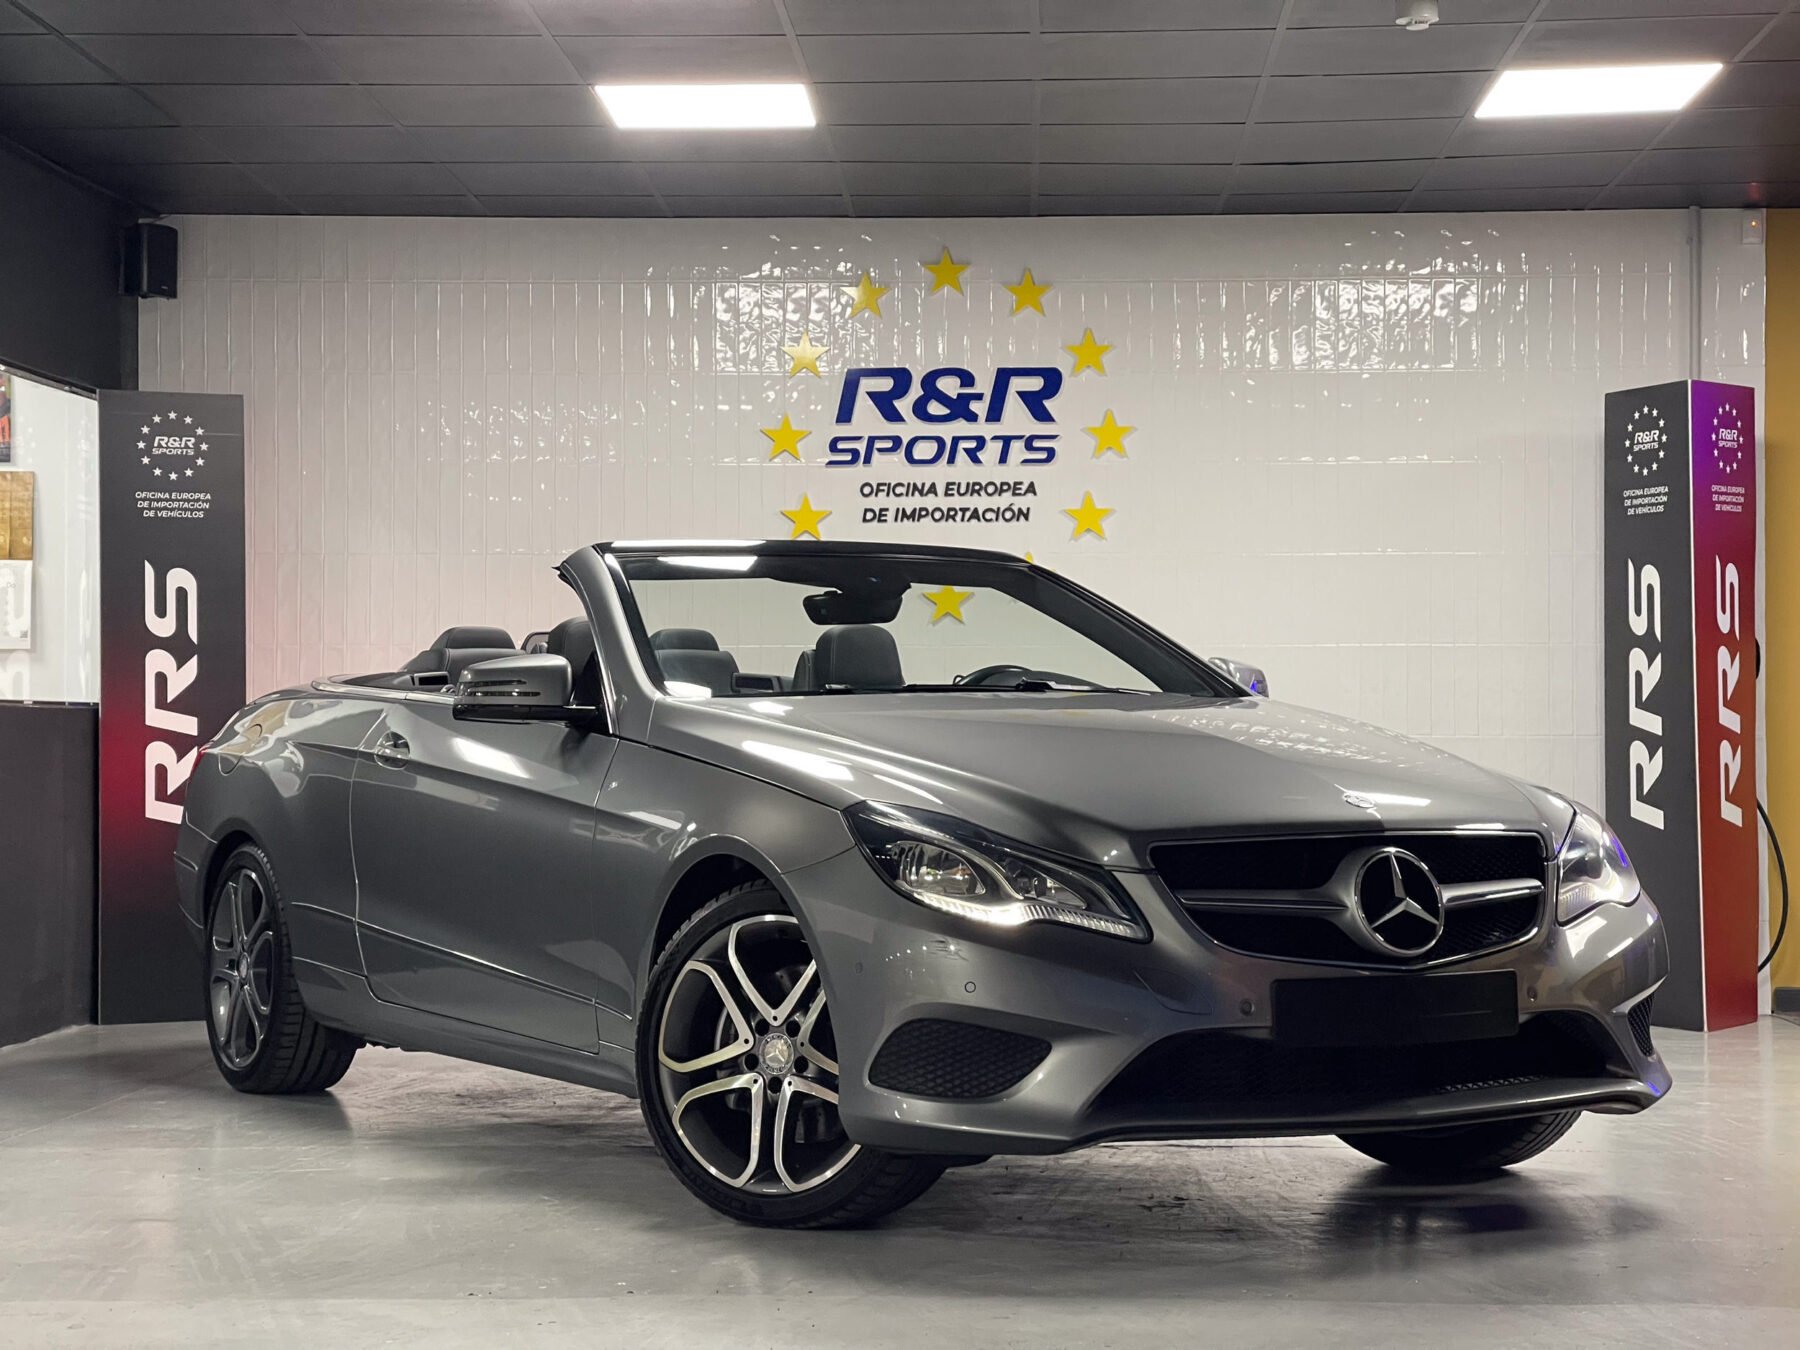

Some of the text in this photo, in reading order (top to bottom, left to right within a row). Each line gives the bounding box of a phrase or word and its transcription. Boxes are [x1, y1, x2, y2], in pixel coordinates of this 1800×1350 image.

[835, 366, 1063, 425] R&R
[153, 436, 195, 448] R&R
[1634, 430, 1660, 444] R&R
[826, 434, 1061, 467] SPORTS
[1633, 442, 1659, 452] SPORTS
[135, 491, 211, 500] OFICINA EUROPEA
[859, 481, 1037, 498] OFICINA EUROPEA
[1623, 486, 1669, 498] OFICINA EUROPEA
[150, 500, 210, 509] IMPORTACIÓN
[1624, 495, 1668, 507] DE IMPORTACIÓN
[157, 509, 204, 518] VEHÍCULOS
[862, 503, 1030, 523] DE IMPORTACIÓN
[1627, 507, 1635, 516] DE
[144, 560, 198, 825] RRS
[1627, 558, 1665, 830] RRS
[1715, 555, 1743, 829] RRS
